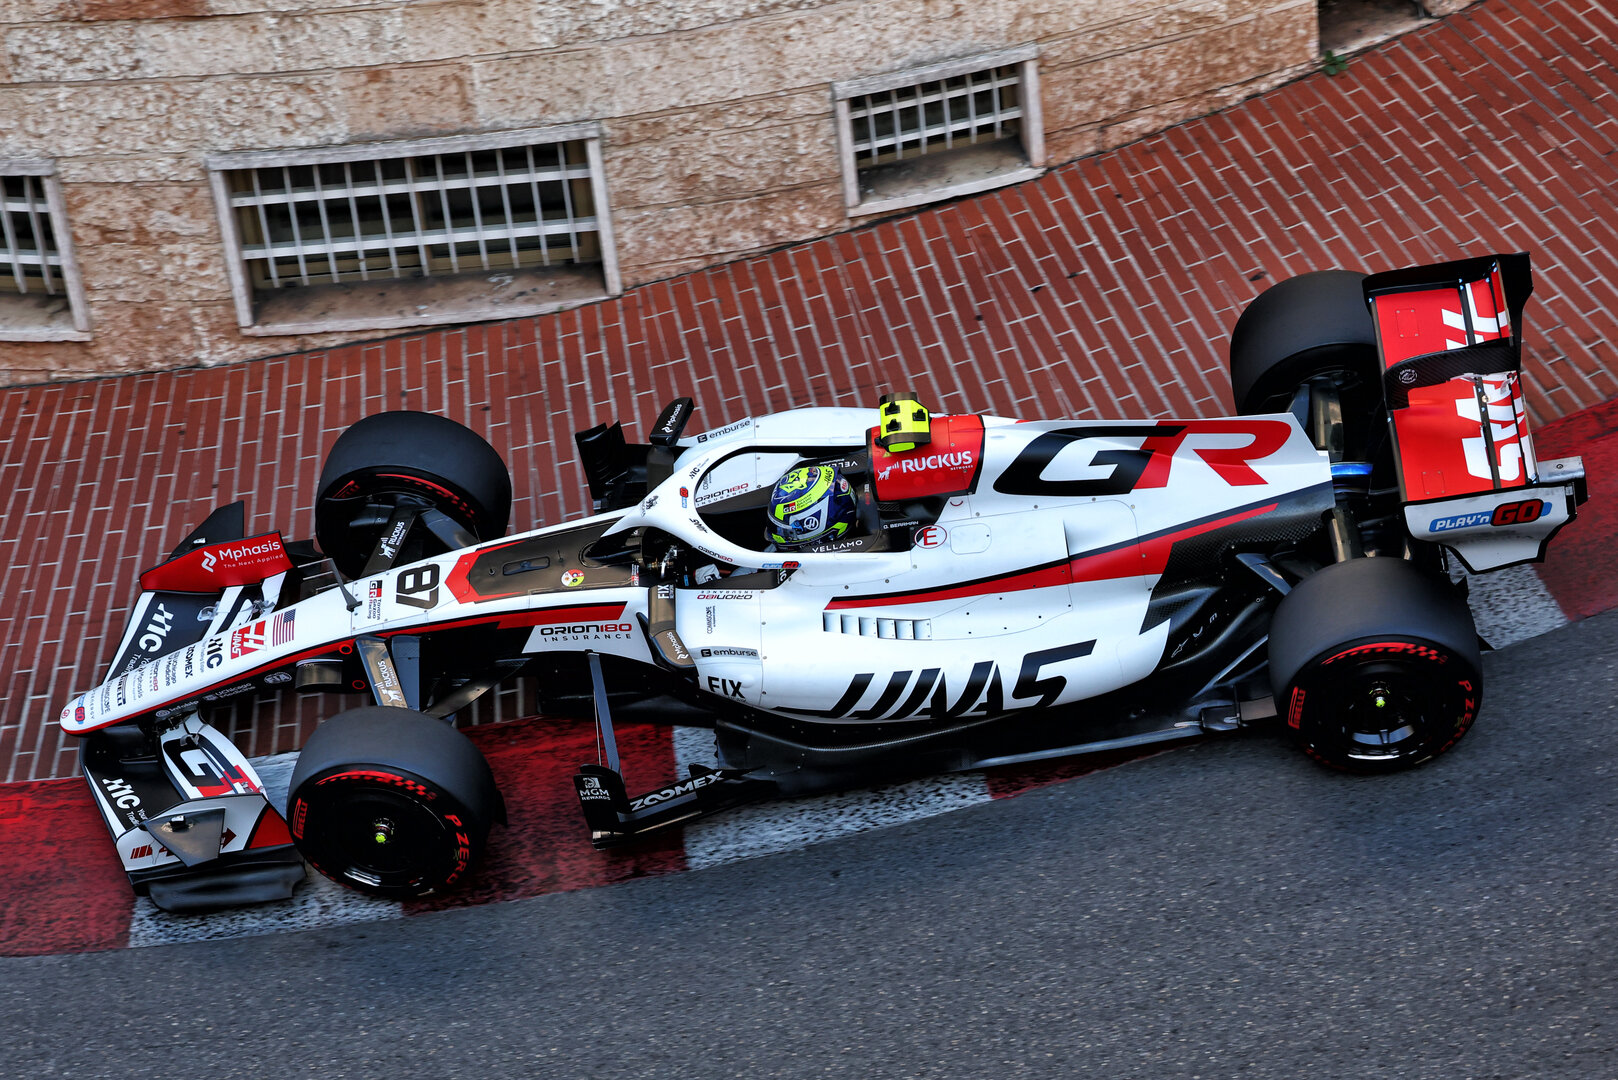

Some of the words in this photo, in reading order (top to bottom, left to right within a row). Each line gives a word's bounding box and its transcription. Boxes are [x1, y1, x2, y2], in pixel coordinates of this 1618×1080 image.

[666, 404, 683, 427] Mphasis
[709, 419, 751, 439] emburse
[901, 450, 973, 473] RUCKUS
[992, 420, 1292, 497] GR
[695, 482, 749, 503] ORION180
[1435, 515, 1490, 531] PLAY'n
[1494, 500, 1542, 526] GO
[388, 521, 405, 545] RUCKUS
[923, 527, 938, 546] E
[219, 540, 281, 561] Mphasis
[812, 540, 863, 553] VELLAMO
[256, 553, 284, 564] Applied
[782, 561, 800, 569] GO
[369, 580, 378, 599] GR
[396, 563, 441, 610] 87
[657, 584, 670, 599] FIX
[540, 623, 632, 636] ORION180
[543, 633, 632, 643] INSURANCE
[666, 632, 683, 655] Mphasis
[713, 648, 758, 657] emburse
[185, 645, 196, 679] ZOOMEX
[377, 660, 393, 688] RUCKUS
[707, 676, 746, 699] FIX
[1458, 680, 1473, 692] P
[75, 707, 85, 721] GO
[580, 788, 610, 797] MGM
[629, 770, 724, 812] ZOOMEX
[444, 814, 463, 827] P
[446, 832, 470, 884] ZERO
